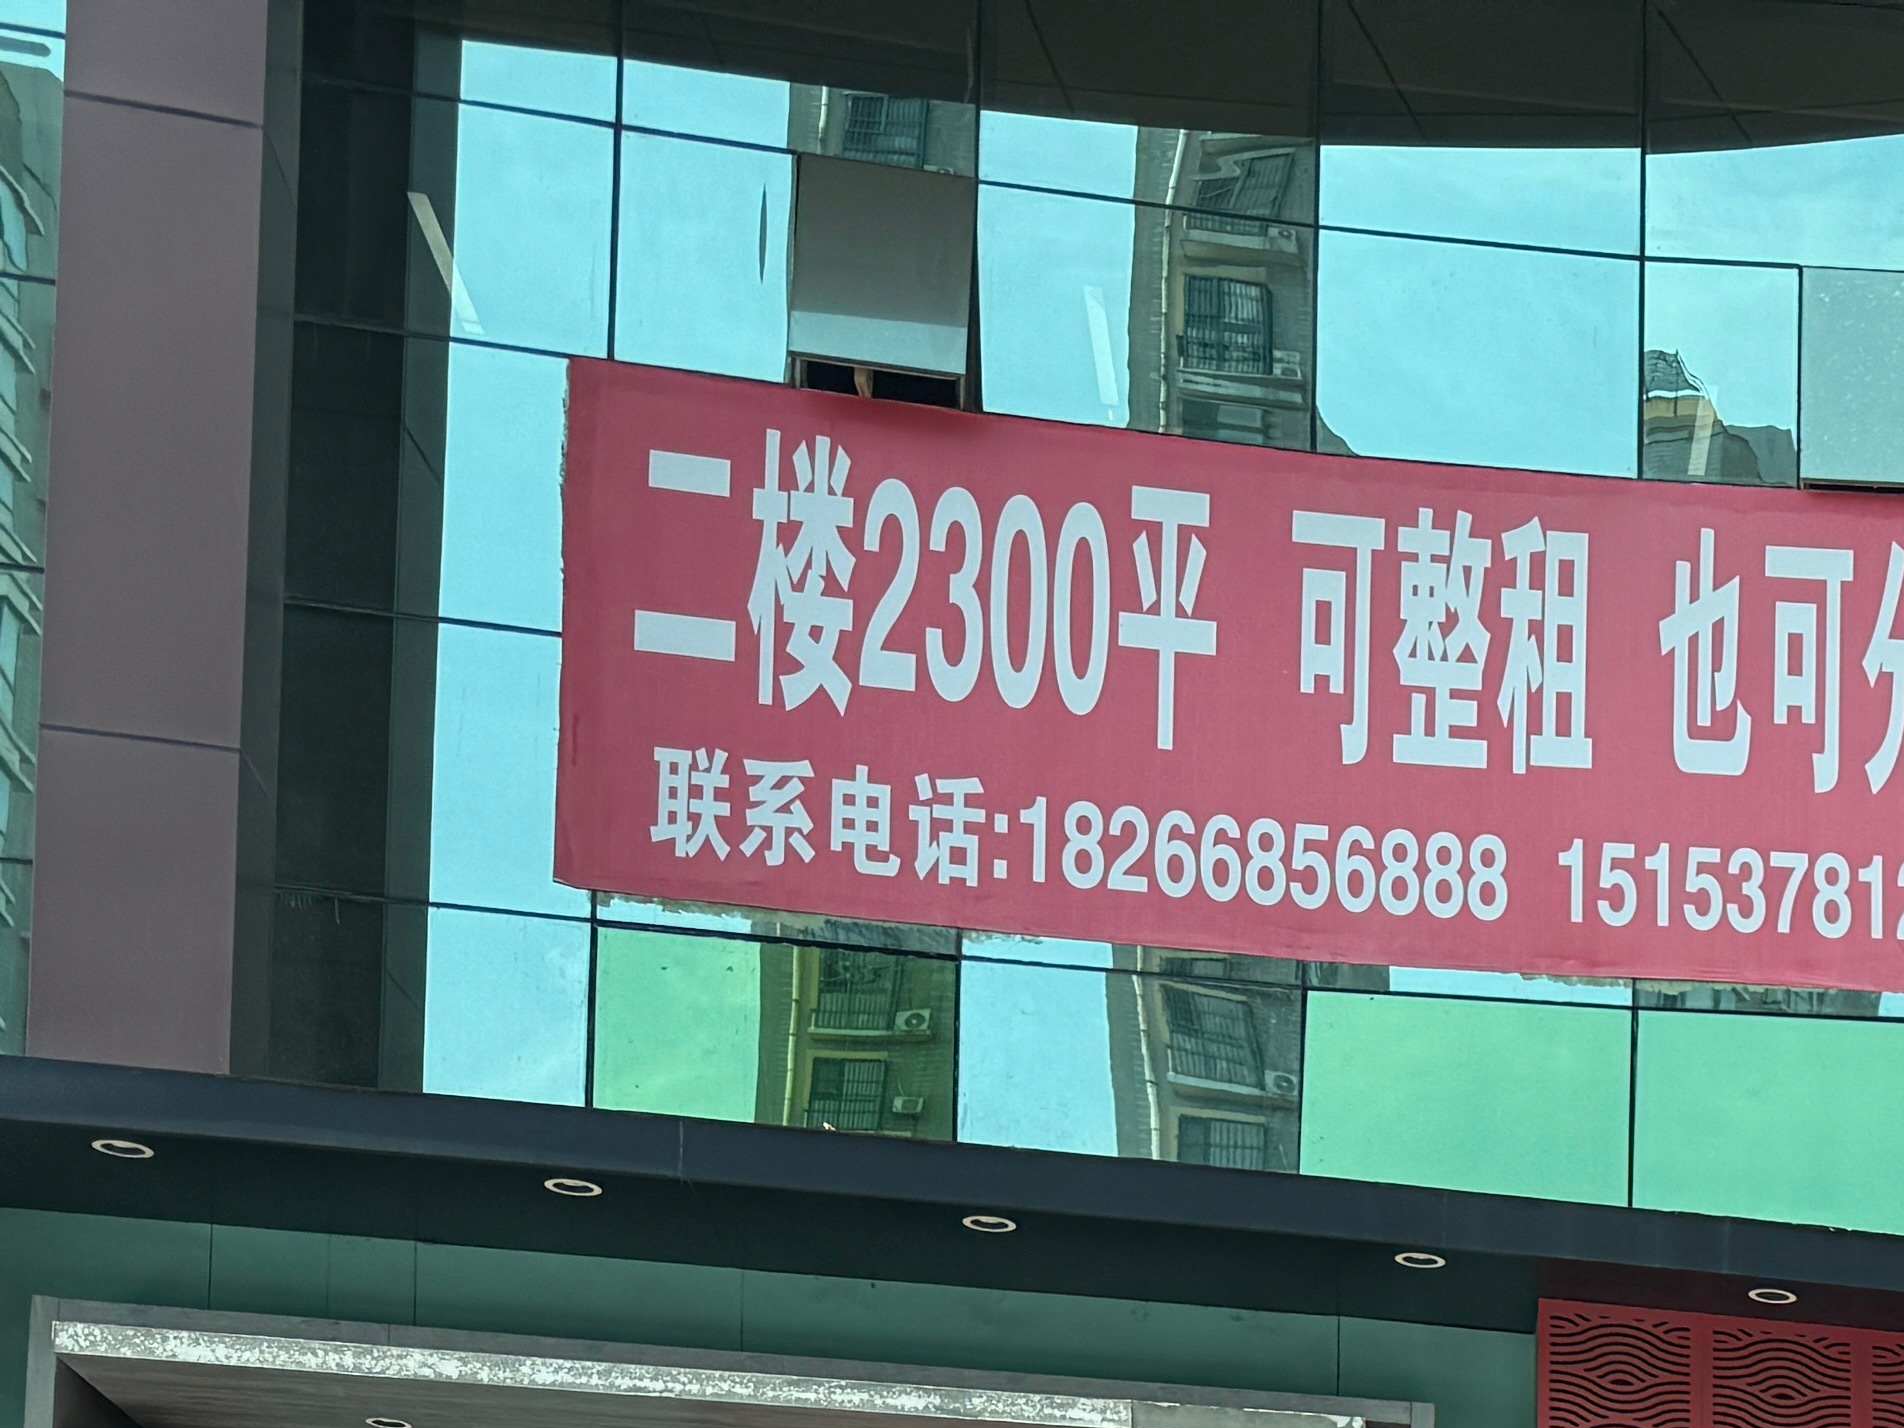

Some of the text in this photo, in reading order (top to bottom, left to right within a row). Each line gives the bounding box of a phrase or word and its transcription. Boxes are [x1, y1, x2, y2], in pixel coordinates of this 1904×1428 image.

[633, 426, 1219, 752] 二楼2300平
[1290, 508, 1594, 776] 可整租
[648, 746, 1508, 924] 联系电话:18266856888
